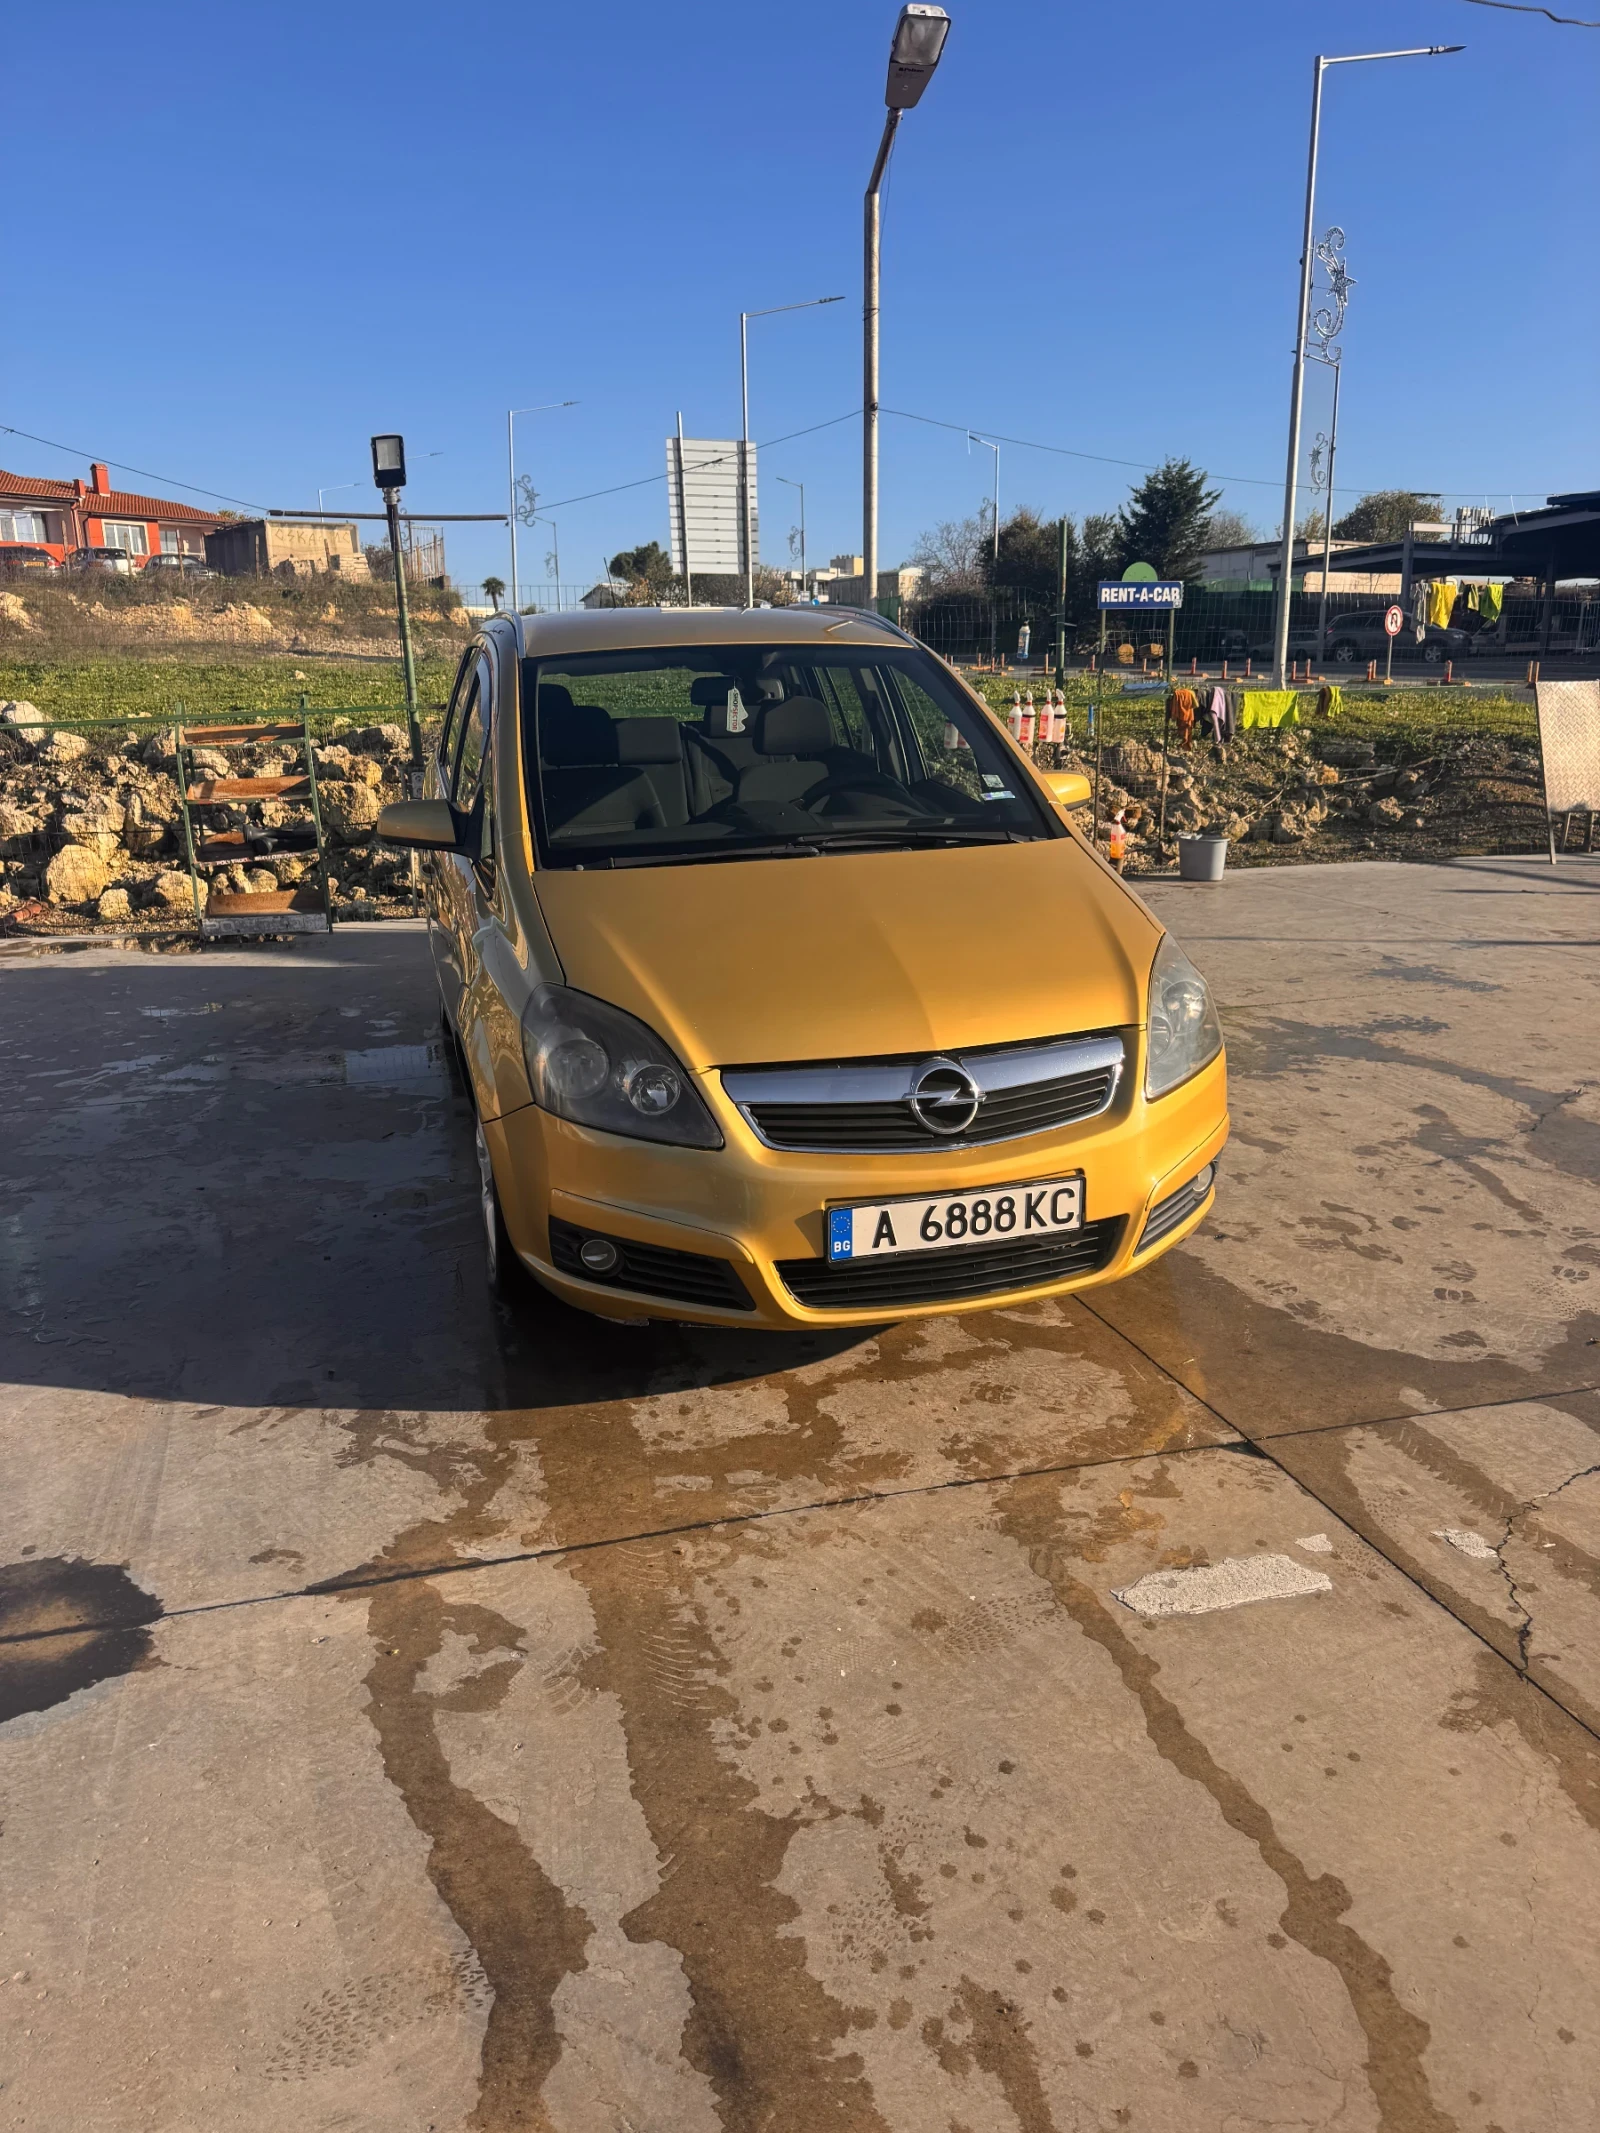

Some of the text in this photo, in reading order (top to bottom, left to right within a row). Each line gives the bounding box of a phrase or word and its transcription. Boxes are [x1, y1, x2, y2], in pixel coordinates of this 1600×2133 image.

[1101, 587, 1180, 602] RENT-A-CAR
[872, 1187, 1075, 1248] A 6888 KC
[834, 1240, 851, 1253] BG
